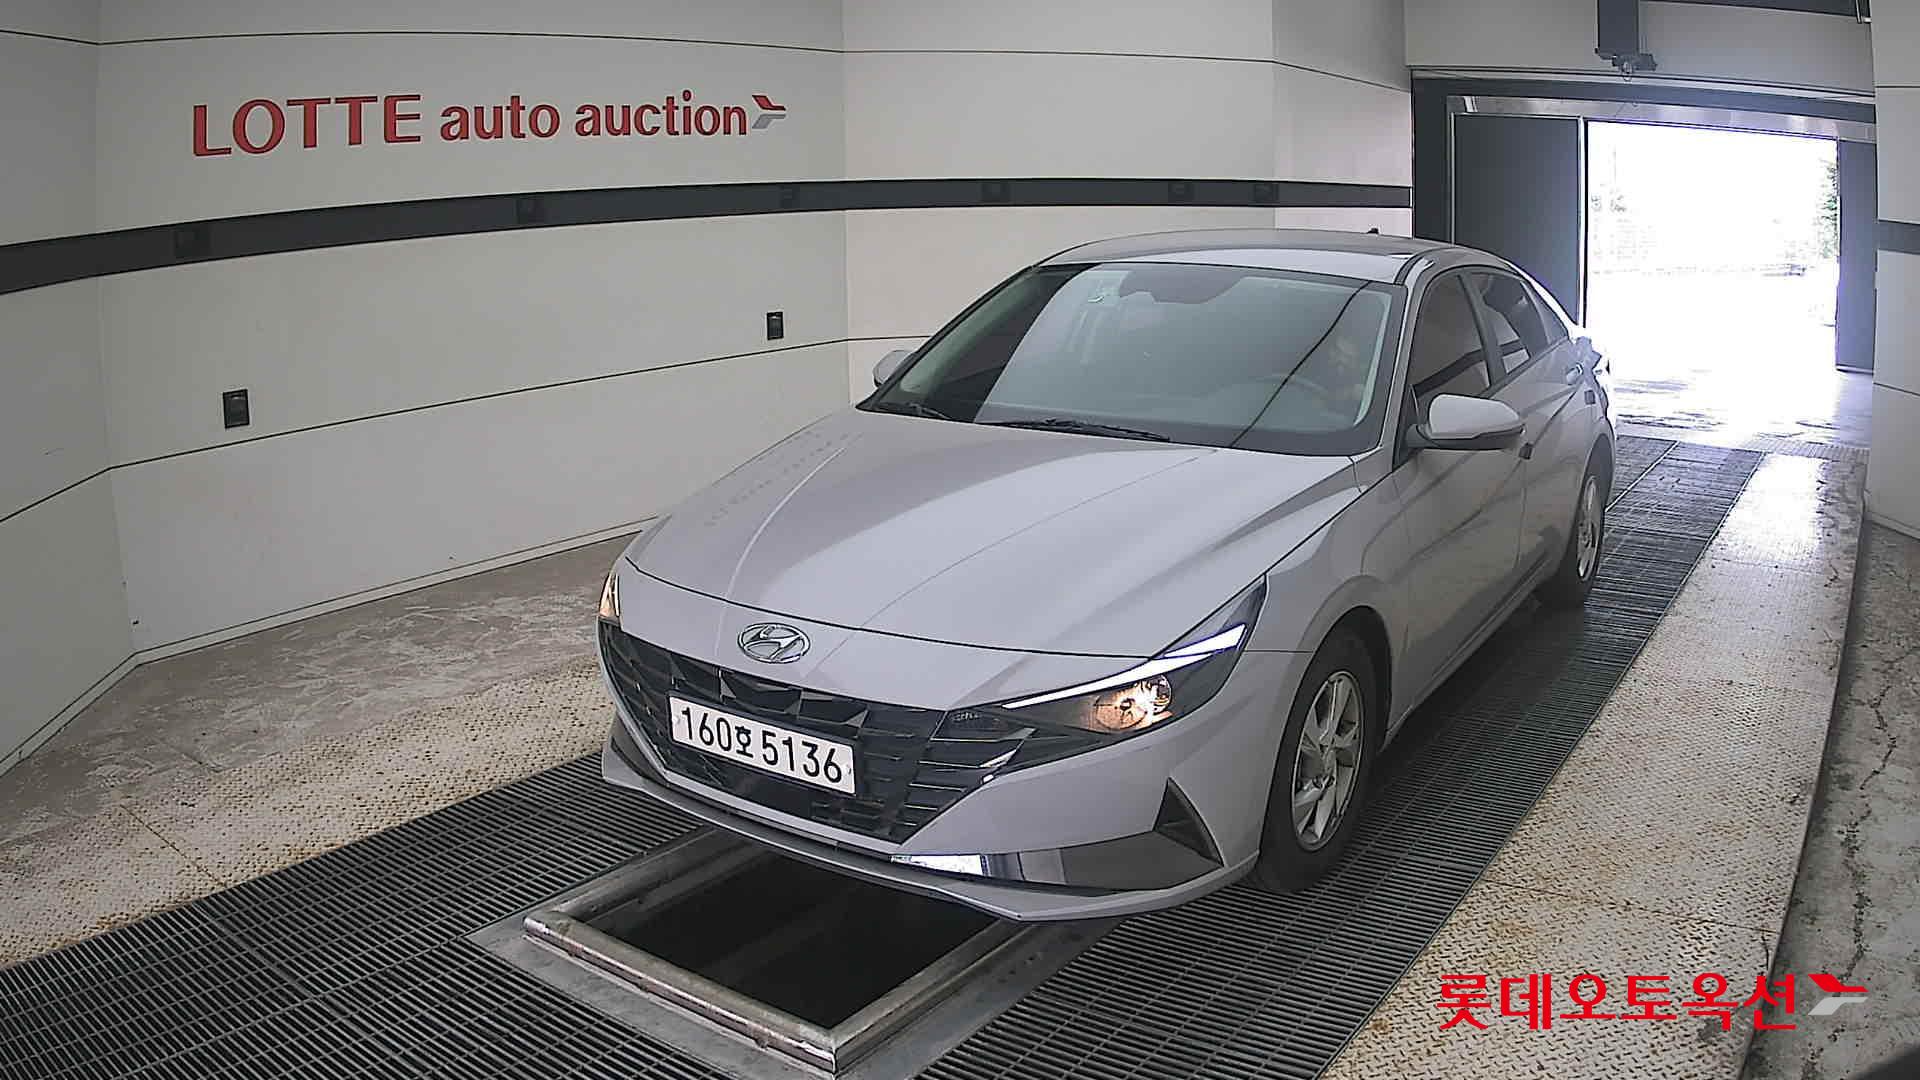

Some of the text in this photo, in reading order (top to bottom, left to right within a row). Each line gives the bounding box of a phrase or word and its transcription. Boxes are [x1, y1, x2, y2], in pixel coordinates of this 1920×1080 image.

[193, 91, 748, 156] LOTTE auto auction
